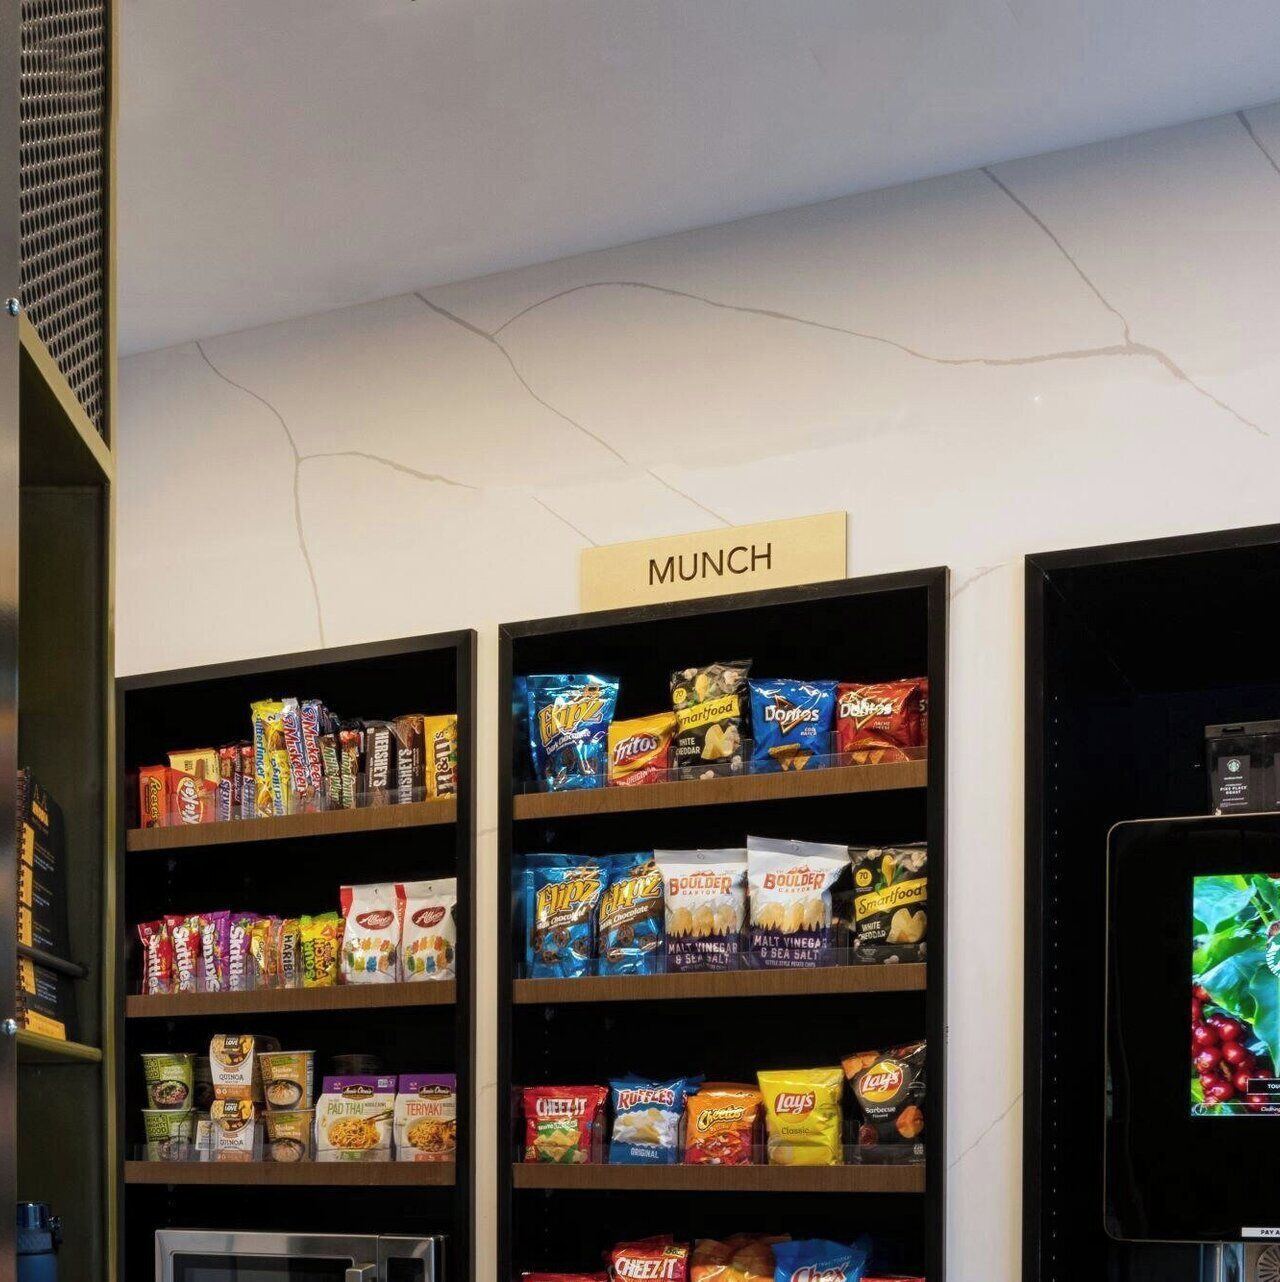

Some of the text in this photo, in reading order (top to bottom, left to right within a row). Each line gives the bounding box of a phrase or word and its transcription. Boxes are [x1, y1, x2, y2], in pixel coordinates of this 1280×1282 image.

[649, 542, 772, 586] MUNCH
[764, 704, 820, 724] Doritos
[614, 735, 659, 766] Fritos
[763, 872, 826, 890] BOULDER
[858, 871, 869, 880] 70
[669, 874, 733, 897] BOULDER
[536, 878, 601, 922] Flipz
[613, 905, 649, 924] Chocolate
[668, 942, 738, 954] MALT VINEGAR
[753, 935, 780, 947] MALT
[303, 940, 316, 981] SOUR
[685, 953, 703, 964] SEA
[771, 949, 790, 959] SEA
[793, 950, 819, 960] SALT
[862, 1069, 900, 1093] Lay's
[327, 1101, 364, 1115] PAD THAI
[405, 1102, 442, 1116] TERIYAKI
[618, 1089, 675, 1110] RUFFLES
[775, 1092, 815, 1115] Lay's
[697, 1105, 744, 1132] Cheetos
[781, 1127, 811, 1135] Classic
